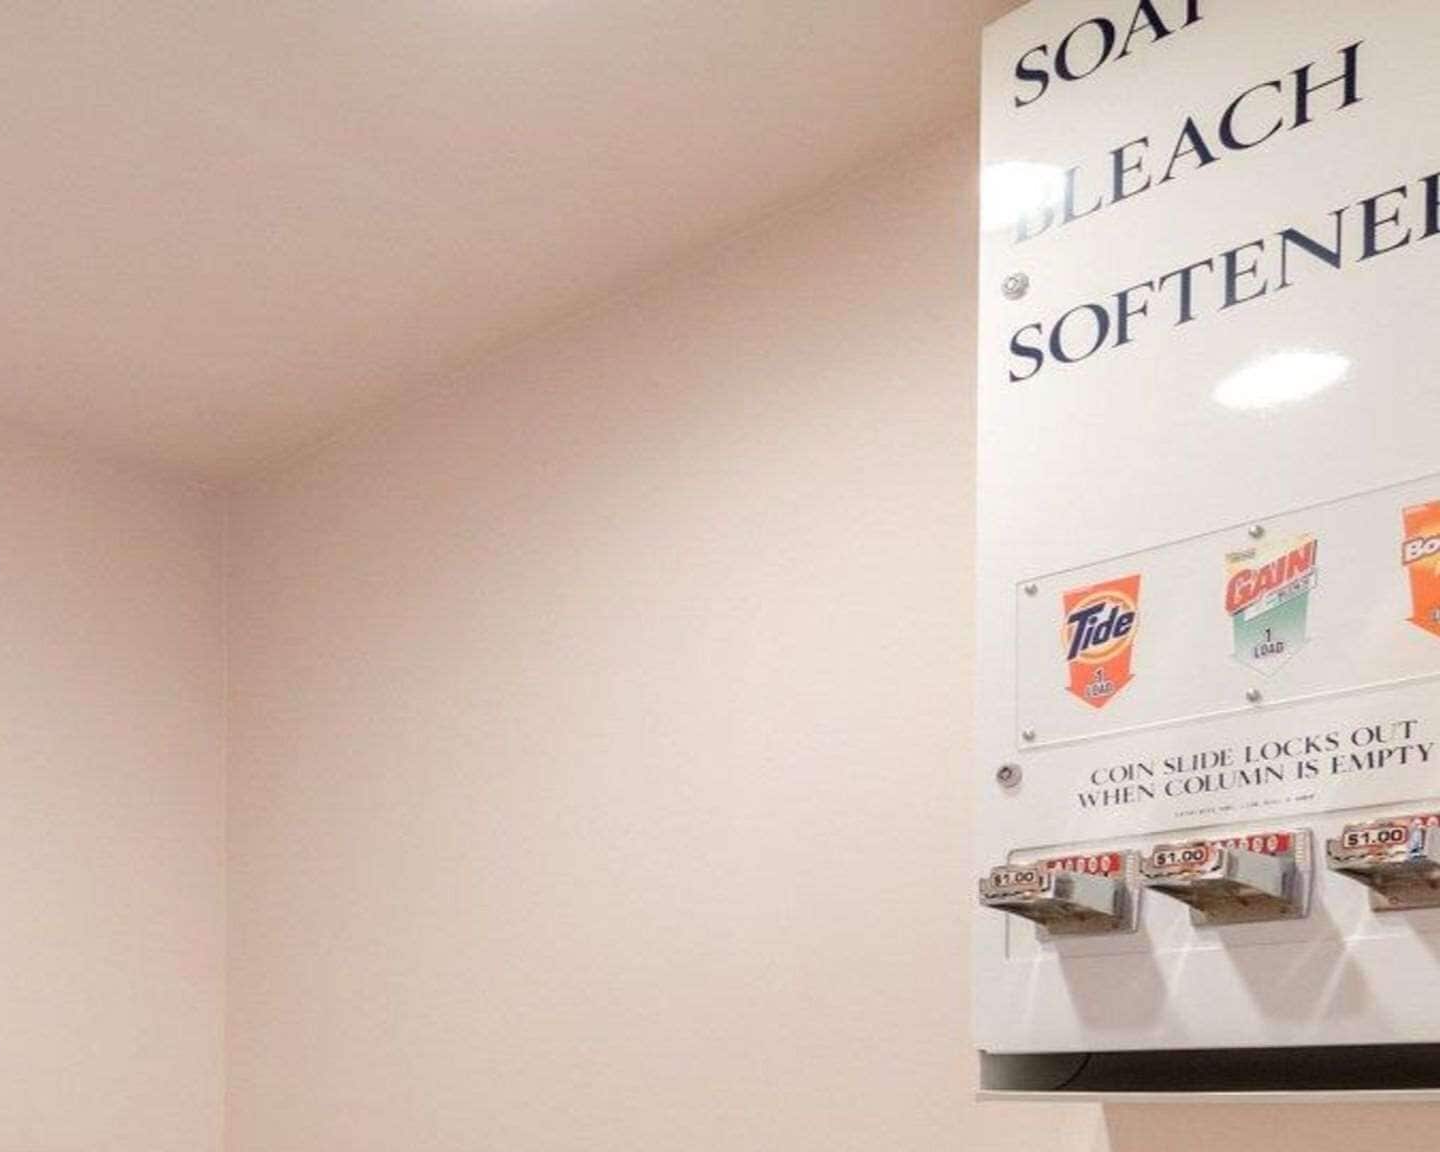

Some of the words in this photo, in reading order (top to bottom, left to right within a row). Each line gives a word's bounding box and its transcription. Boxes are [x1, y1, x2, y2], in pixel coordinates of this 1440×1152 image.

[1067, 602, 1135, 660] Tide
[1265, 628, 1272, 642] 1
[1254, 641, 1285, 658] LOAD
[1091, 763, 1154, 786] COIN
[1164, 750, 1233, 775] SLIDE
[1245, 731, 1340, 763] LOCKS
[1351, 720, 1418, 747] OUT
[1078, 785, 1154, 807] WHEN
[1165, 765, 1284, 797] COLUMN
[1297, 759, 1318, 779] IS
[1332, 742, 1434, 773] EMPTY
[1348, 829, 1403, 845] $1.00
[1157, 850, 1204, 866] $1.00
[993, 871, 1034, 887] $1.00
